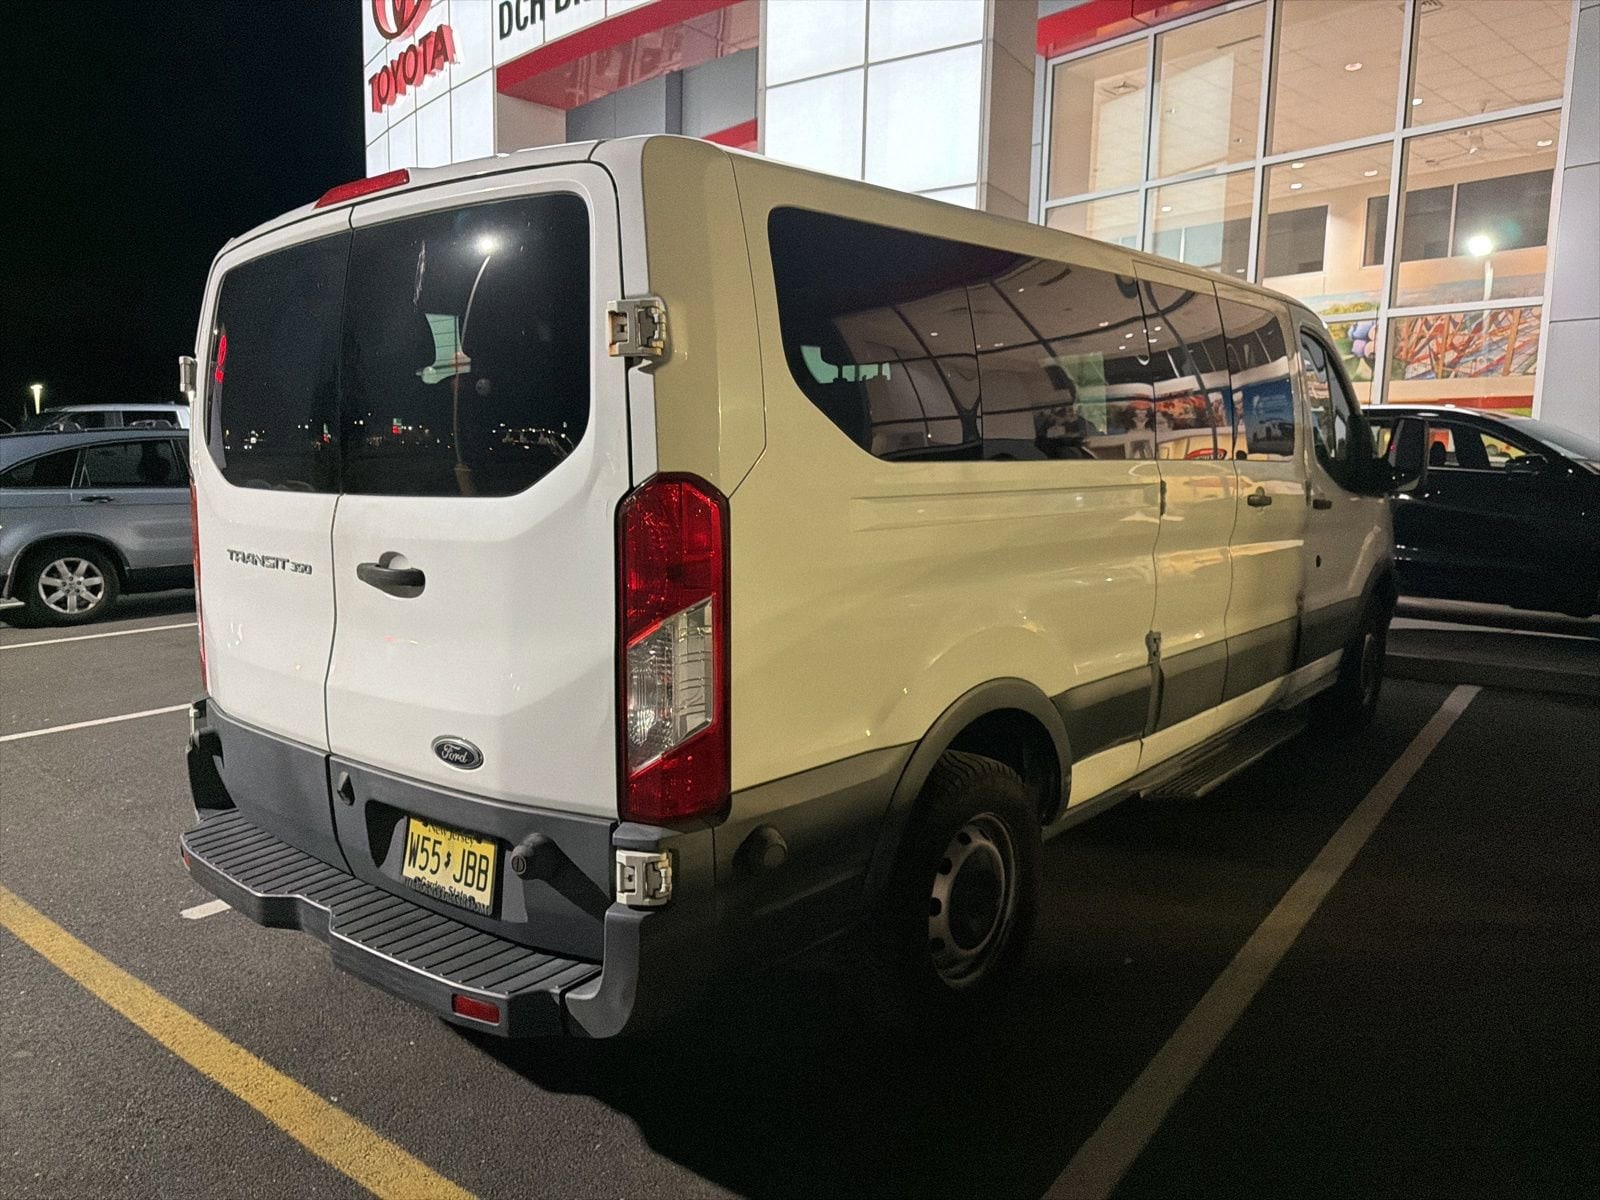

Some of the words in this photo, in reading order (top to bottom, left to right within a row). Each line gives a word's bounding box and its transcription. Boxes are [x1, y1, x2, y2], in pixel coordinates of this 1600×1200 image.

[368, 24, 456, 113] TOYOTA
[226, 548, 290, 571] TRANSIT
[441, 743, 469, 763] Ford
[407, 831, 443, 875] W55
[452, 848, 490, 892] JBB
